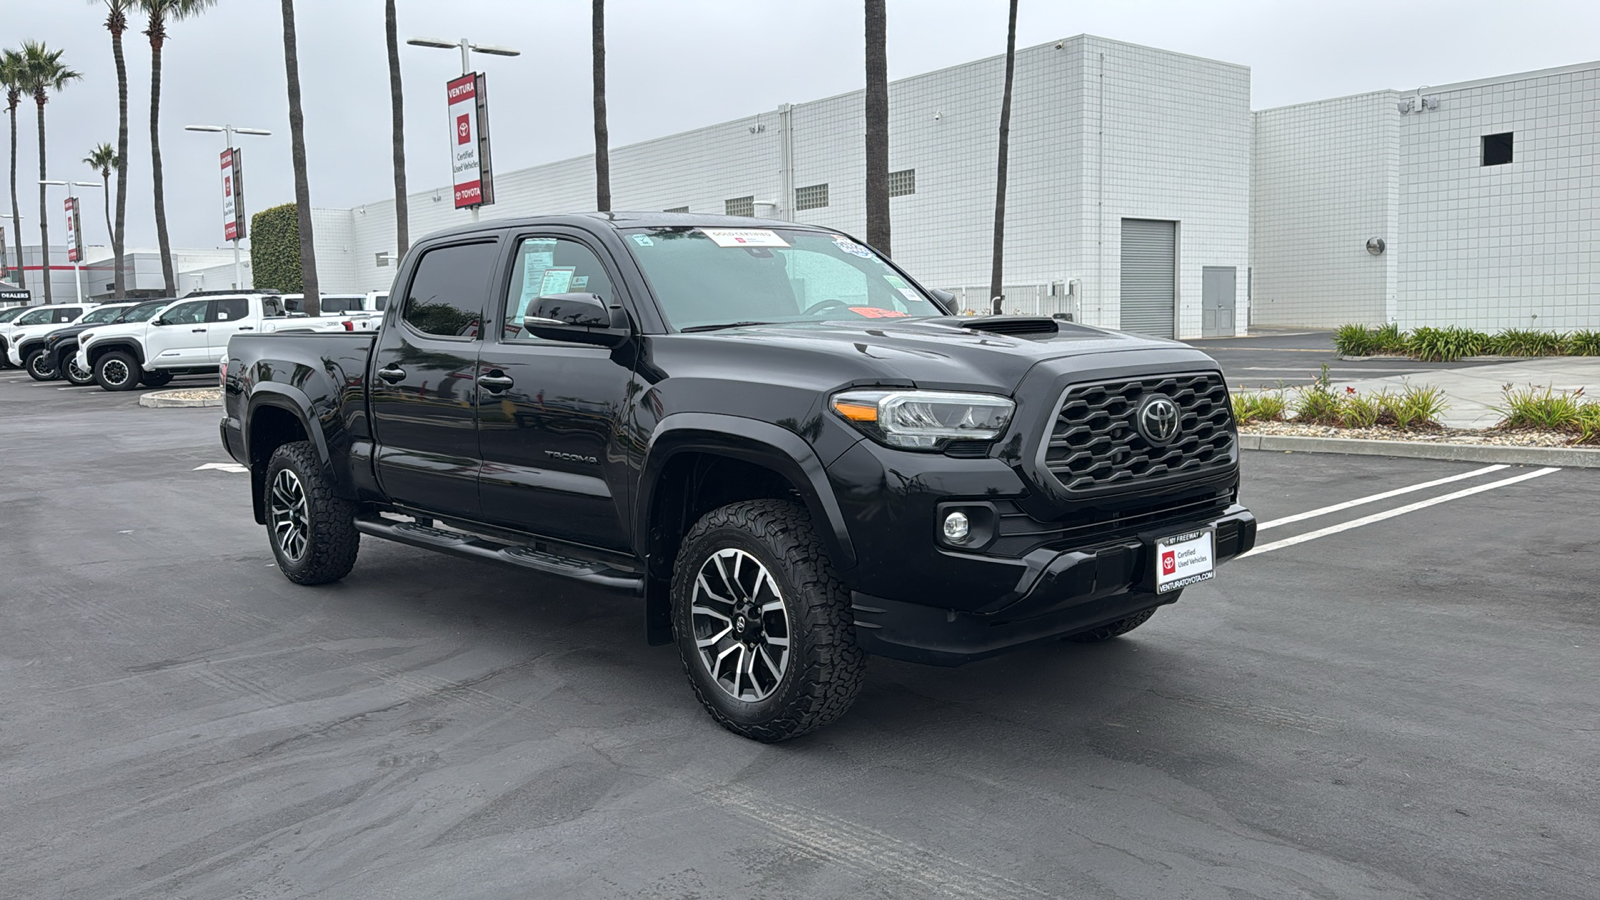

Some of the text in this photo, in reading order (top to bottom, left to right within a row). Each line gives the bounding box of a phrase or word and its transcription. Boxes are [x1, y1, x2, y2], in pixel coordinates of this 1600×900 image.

[449, 82, 474, 98] VENTURA
[457, 150, 473, 161] Certified
[464, 160, 479, 170] Vehicles
[461, 187, 480, 198] TOYOTA
[544, 450, 599, 463] TACOMA
[1177, 532, 1199, 543] FREEWAY
[1177, 548, 1196, 559] Certified
[1190, 556, 1207, 565] Vehicles
[1160, 571, 1213, 592] VENTURATOYOTA.COM
